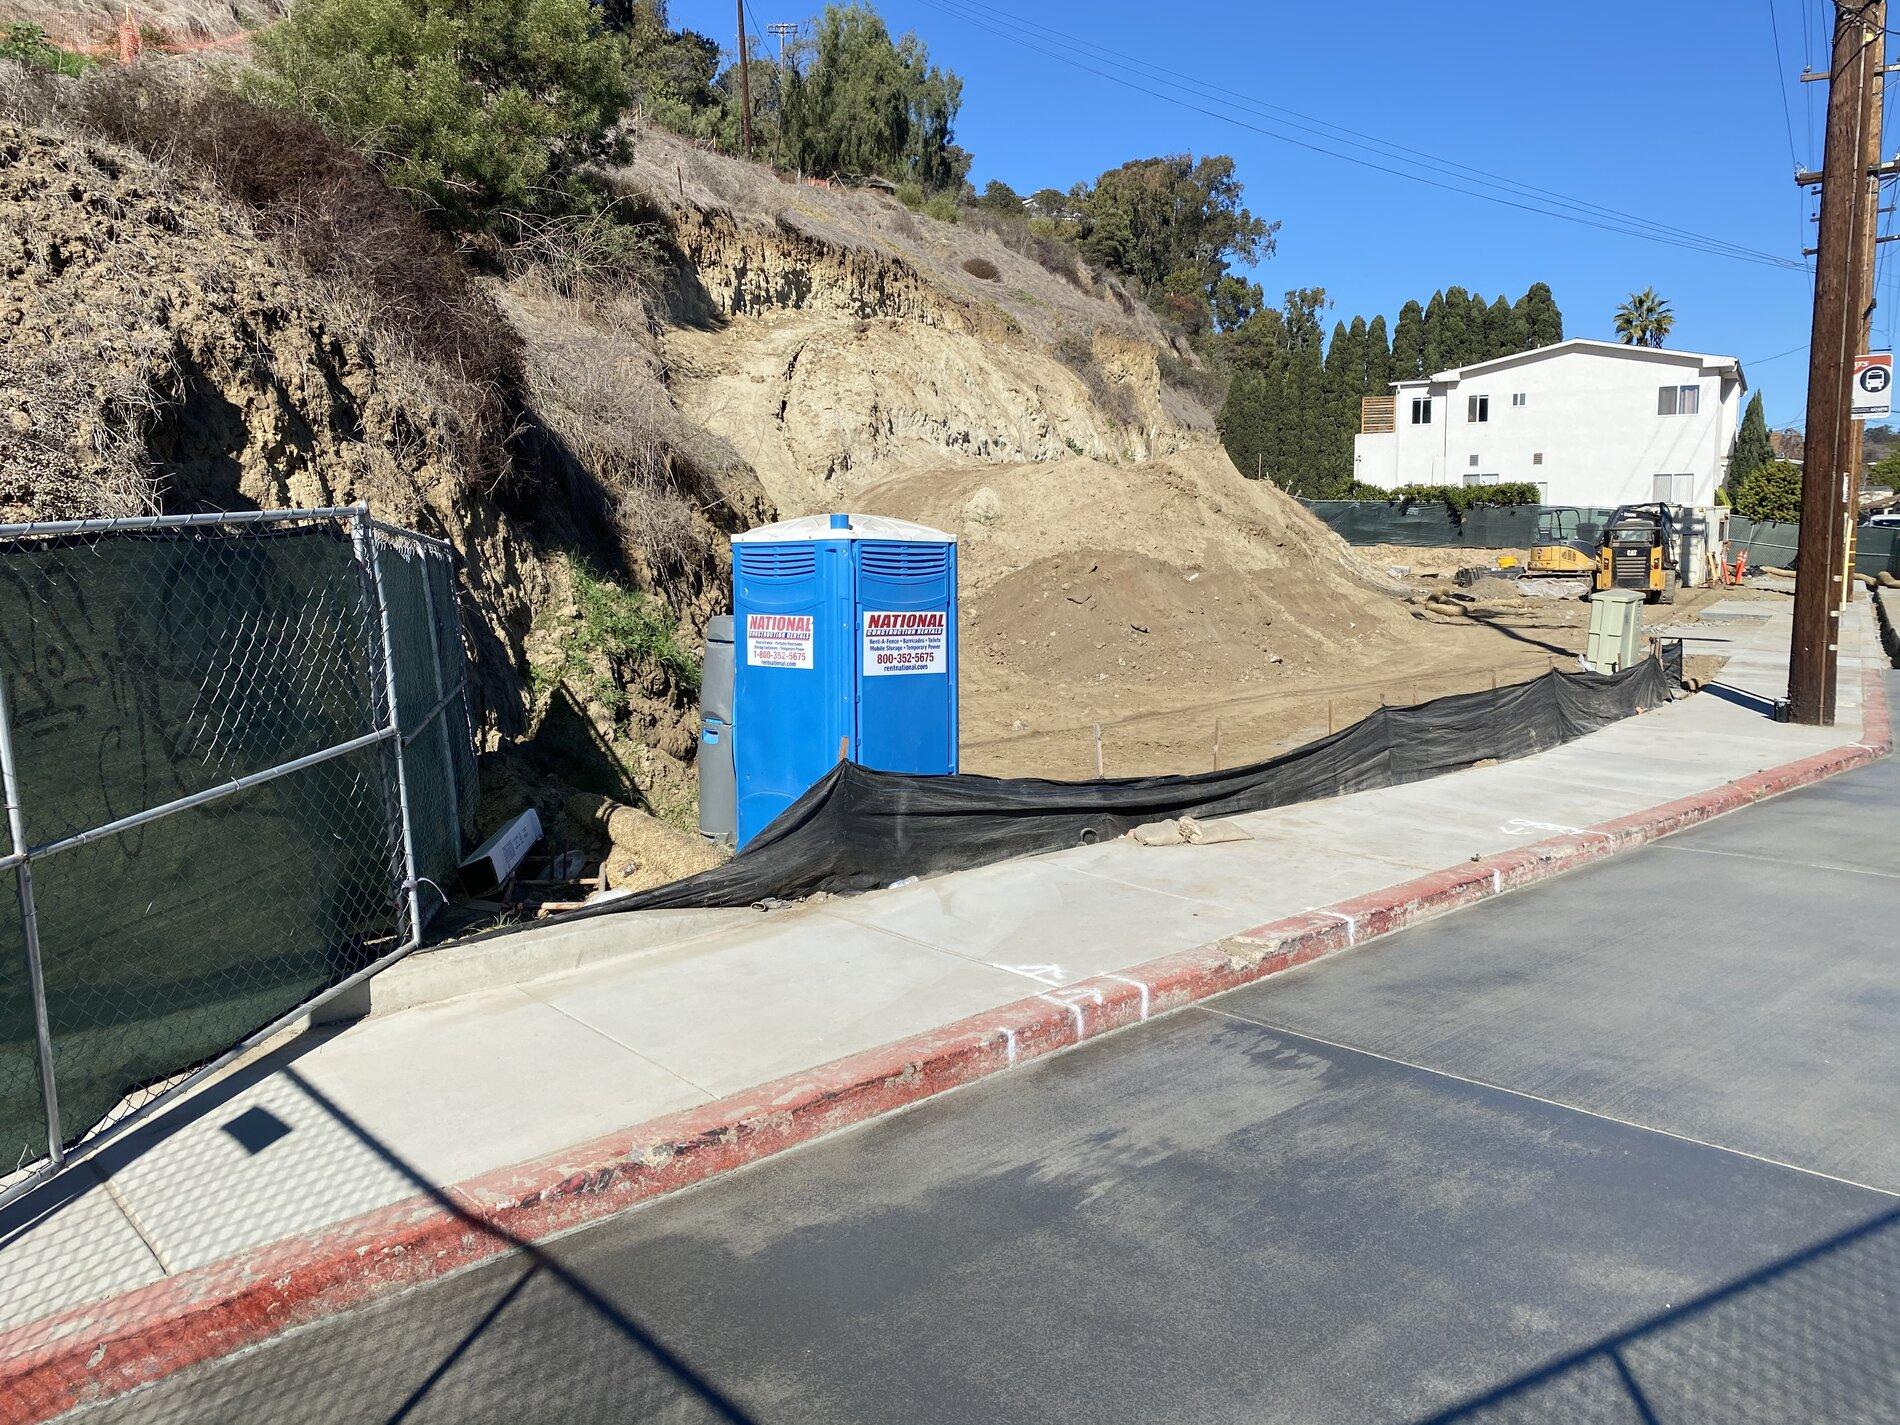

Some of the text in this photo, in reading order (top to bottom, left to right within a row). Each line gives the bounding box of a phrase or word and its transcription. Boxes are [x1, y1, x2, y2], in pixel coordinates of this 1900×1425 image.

[750, 616, 811, 631] NATIONAL
[868, 614, 944, 628] NATIONAL
[866, 628, 916, 636] CONSTRUCTION
[906, 644, 927, 652] Temporary
[754, 650, 806, 661] 1-800-352-5675
[877, 652, 934, 664] 800-352-5675
[884, 664, 928, 672] rentnational.com
